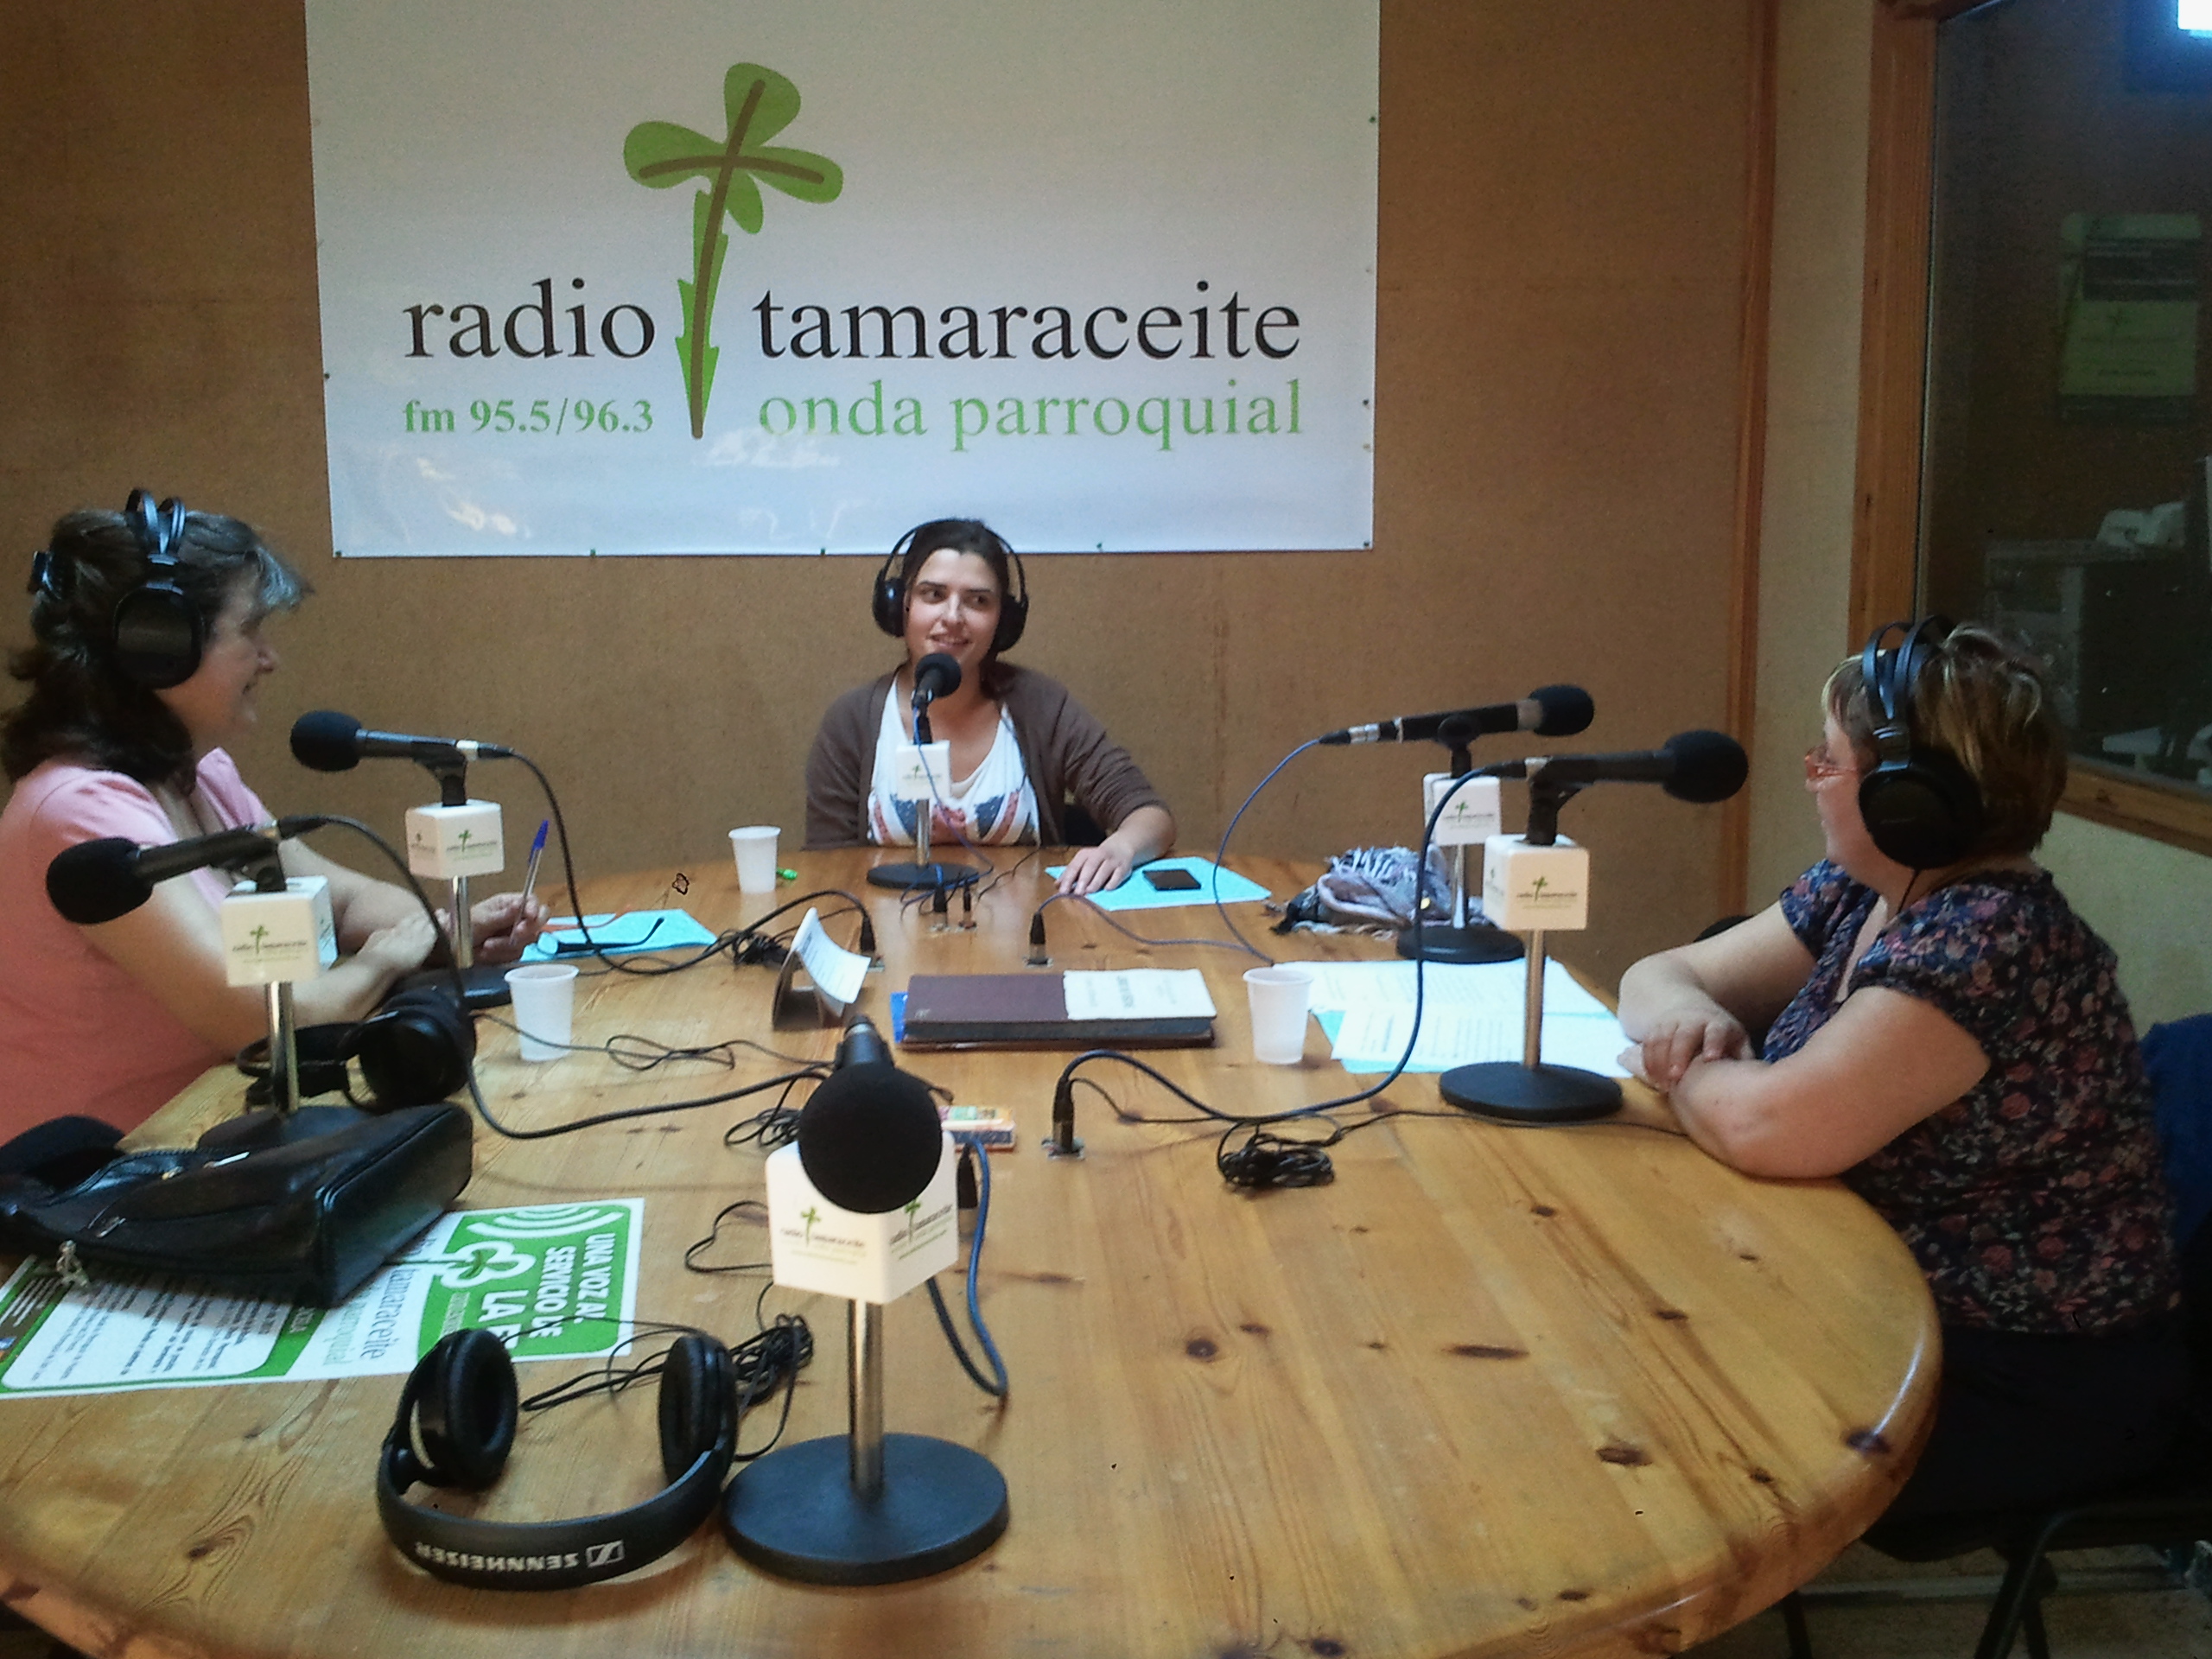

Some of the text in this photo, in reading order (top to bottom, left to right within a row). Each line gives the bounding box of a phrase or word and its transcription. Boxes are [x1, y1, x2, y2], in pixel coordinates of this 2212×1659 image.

[402, 277, 1300, 359] radio tamaraceite
[402, 399, 655, 435] fm 95.5/96.3
[758, 380, 1300, 452] onda parroquial
[582, 1233, 615, 1267] UNA
[529, 1246, 576, 1338] SERVICIO DE
[577, 1267, 612, 1300] VOZ
[359, 1268, 421, 1359] tamaraceite
[478, 1290, 529, 1322] LA
[415, 1541, 579, 1571] SENNHEISER
